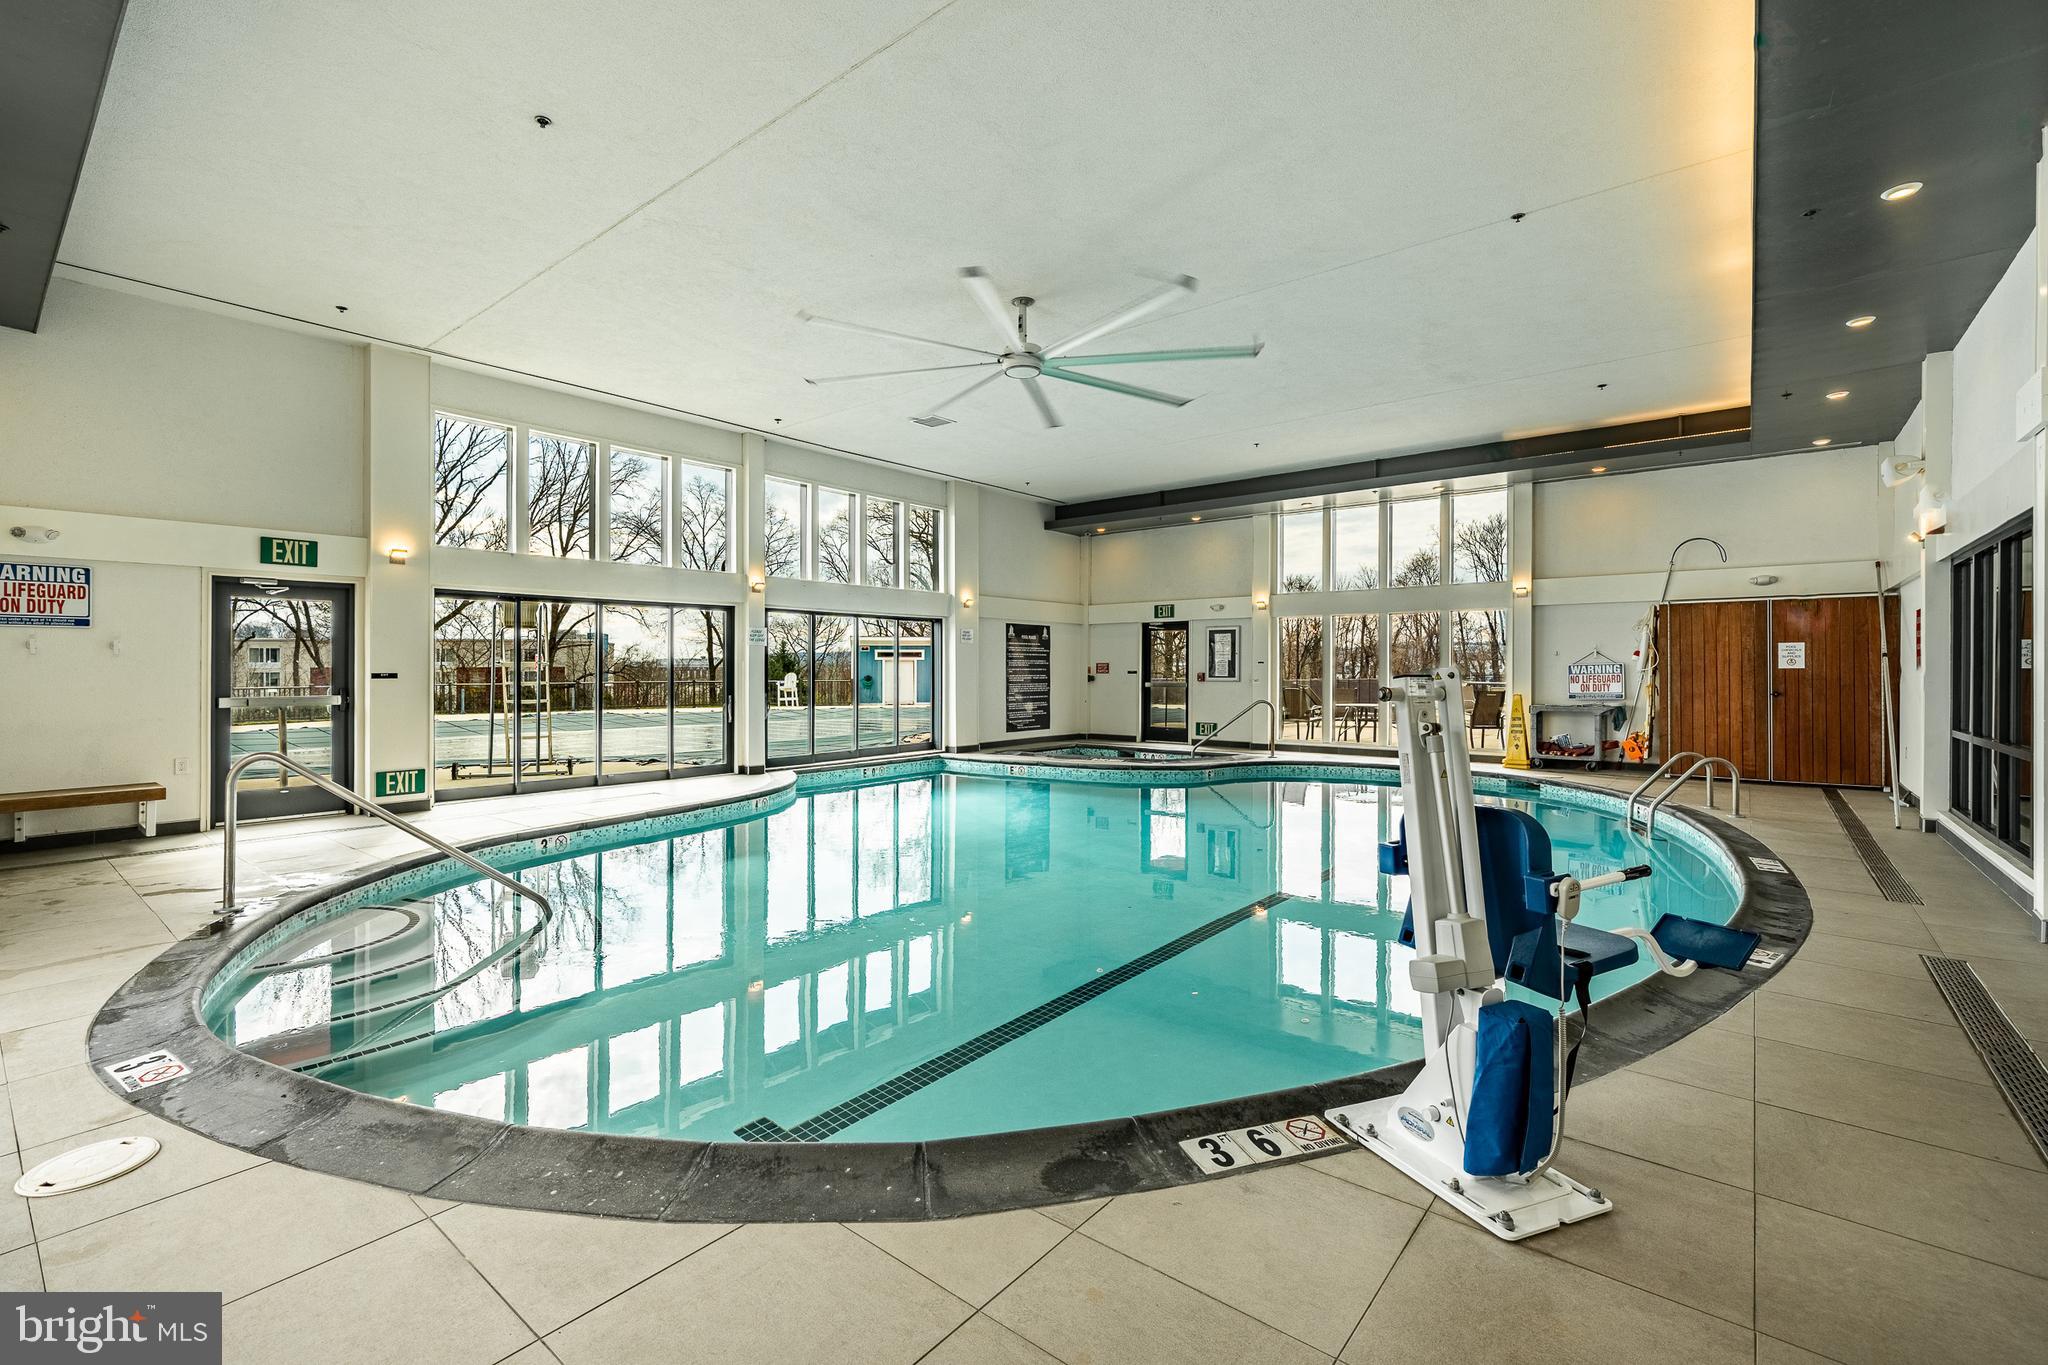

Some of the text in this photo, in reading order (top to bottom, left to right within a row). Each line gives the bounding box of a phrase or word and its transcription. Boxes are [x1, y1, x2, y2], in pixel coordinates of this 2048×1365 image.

[272, 539, 309, 565] EXIT
[0, 564, 86, 583] ARNING
[3, 581, 87, 600] LIFEGUARD
[0, 597, 66, 614] ON DUTY
[1158, 605, 1171, 618] EXIT
[1571, 664, 1621, 674] WARNING
[1570, 674, 1621, 684] NO LIFEGUARD
[1580, 683, 1611, 693] ON DUTY
[1200, 723, 1214, 735] EXIT
[385, 770, 418, 794] EXIT
[113, 1054, 168, 1073] 3
[1246, 1124, 1282, 1157] 6 IN
[1300, 1136, 1345, 1152] NO DIVING
[1198, 1133, 1235, 1167] 3 FT
